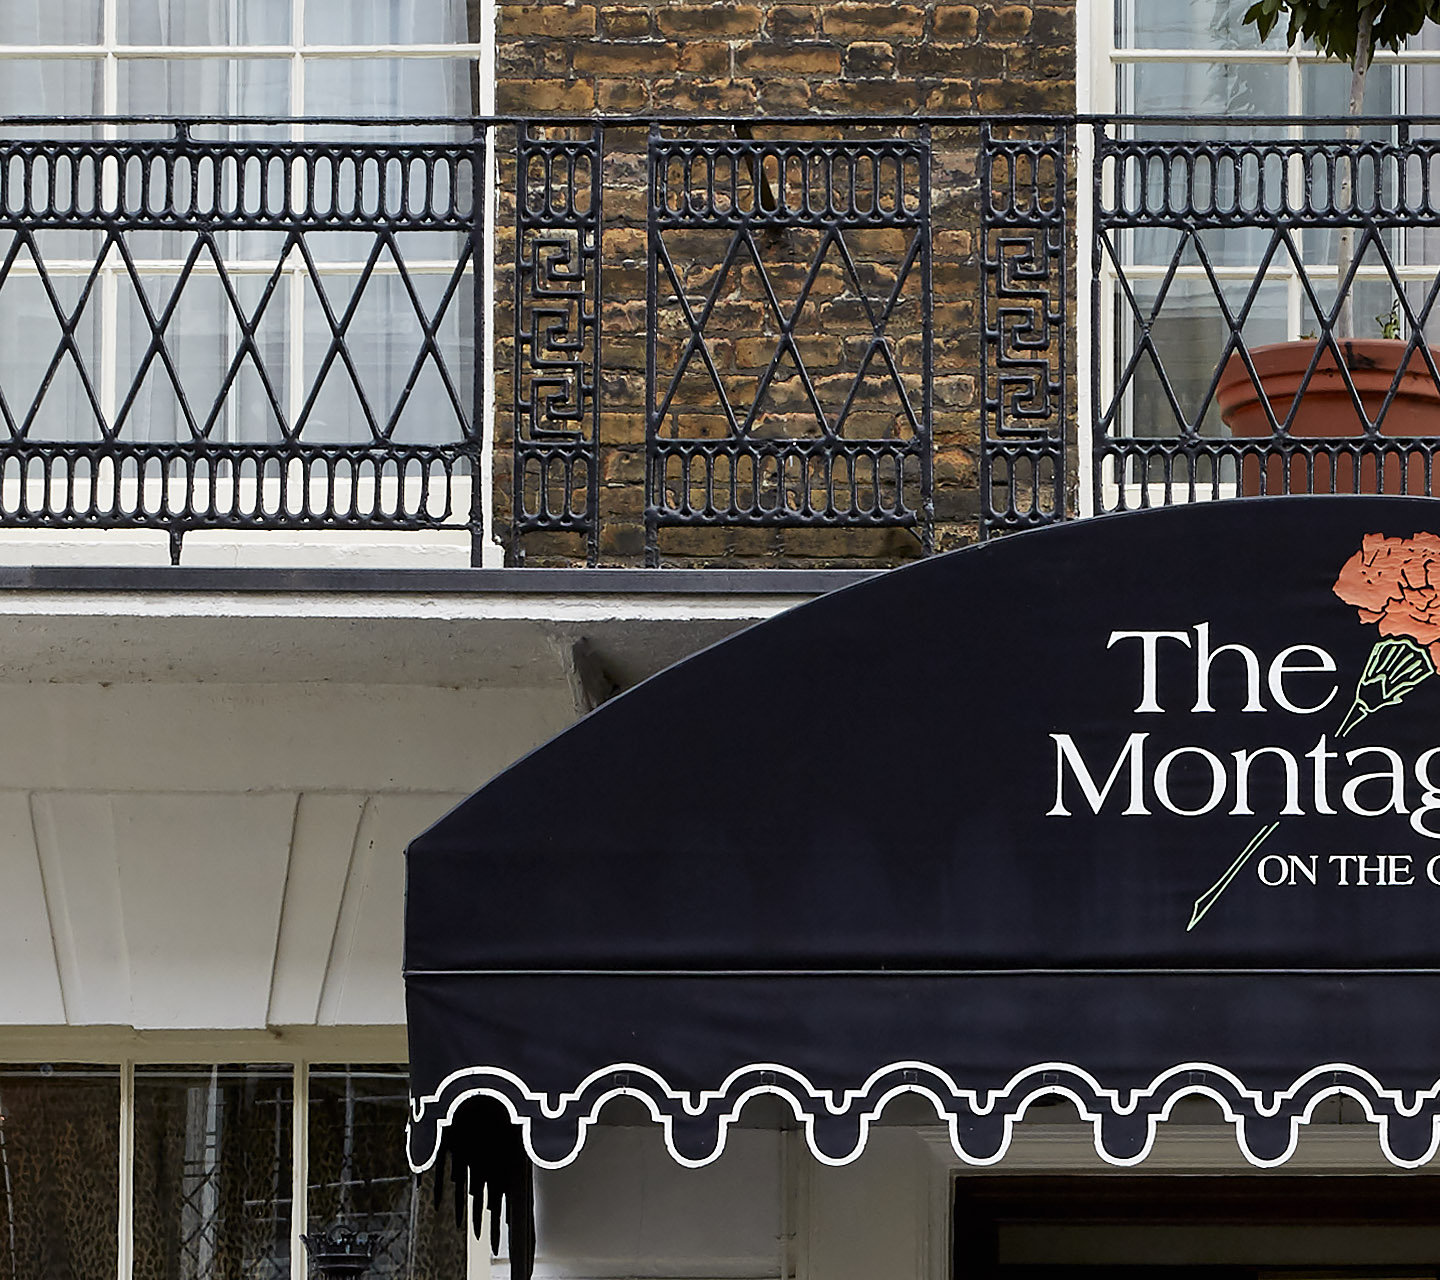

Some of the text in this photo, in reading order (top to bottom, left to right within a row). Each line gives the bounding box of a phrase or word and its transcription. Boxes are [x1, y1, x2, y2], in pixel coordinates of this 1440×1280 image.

[1107, 622, 1338, 713] The
[1258, 855, 1318, 885] ON
[1329, 856, 1414, 885] THE
